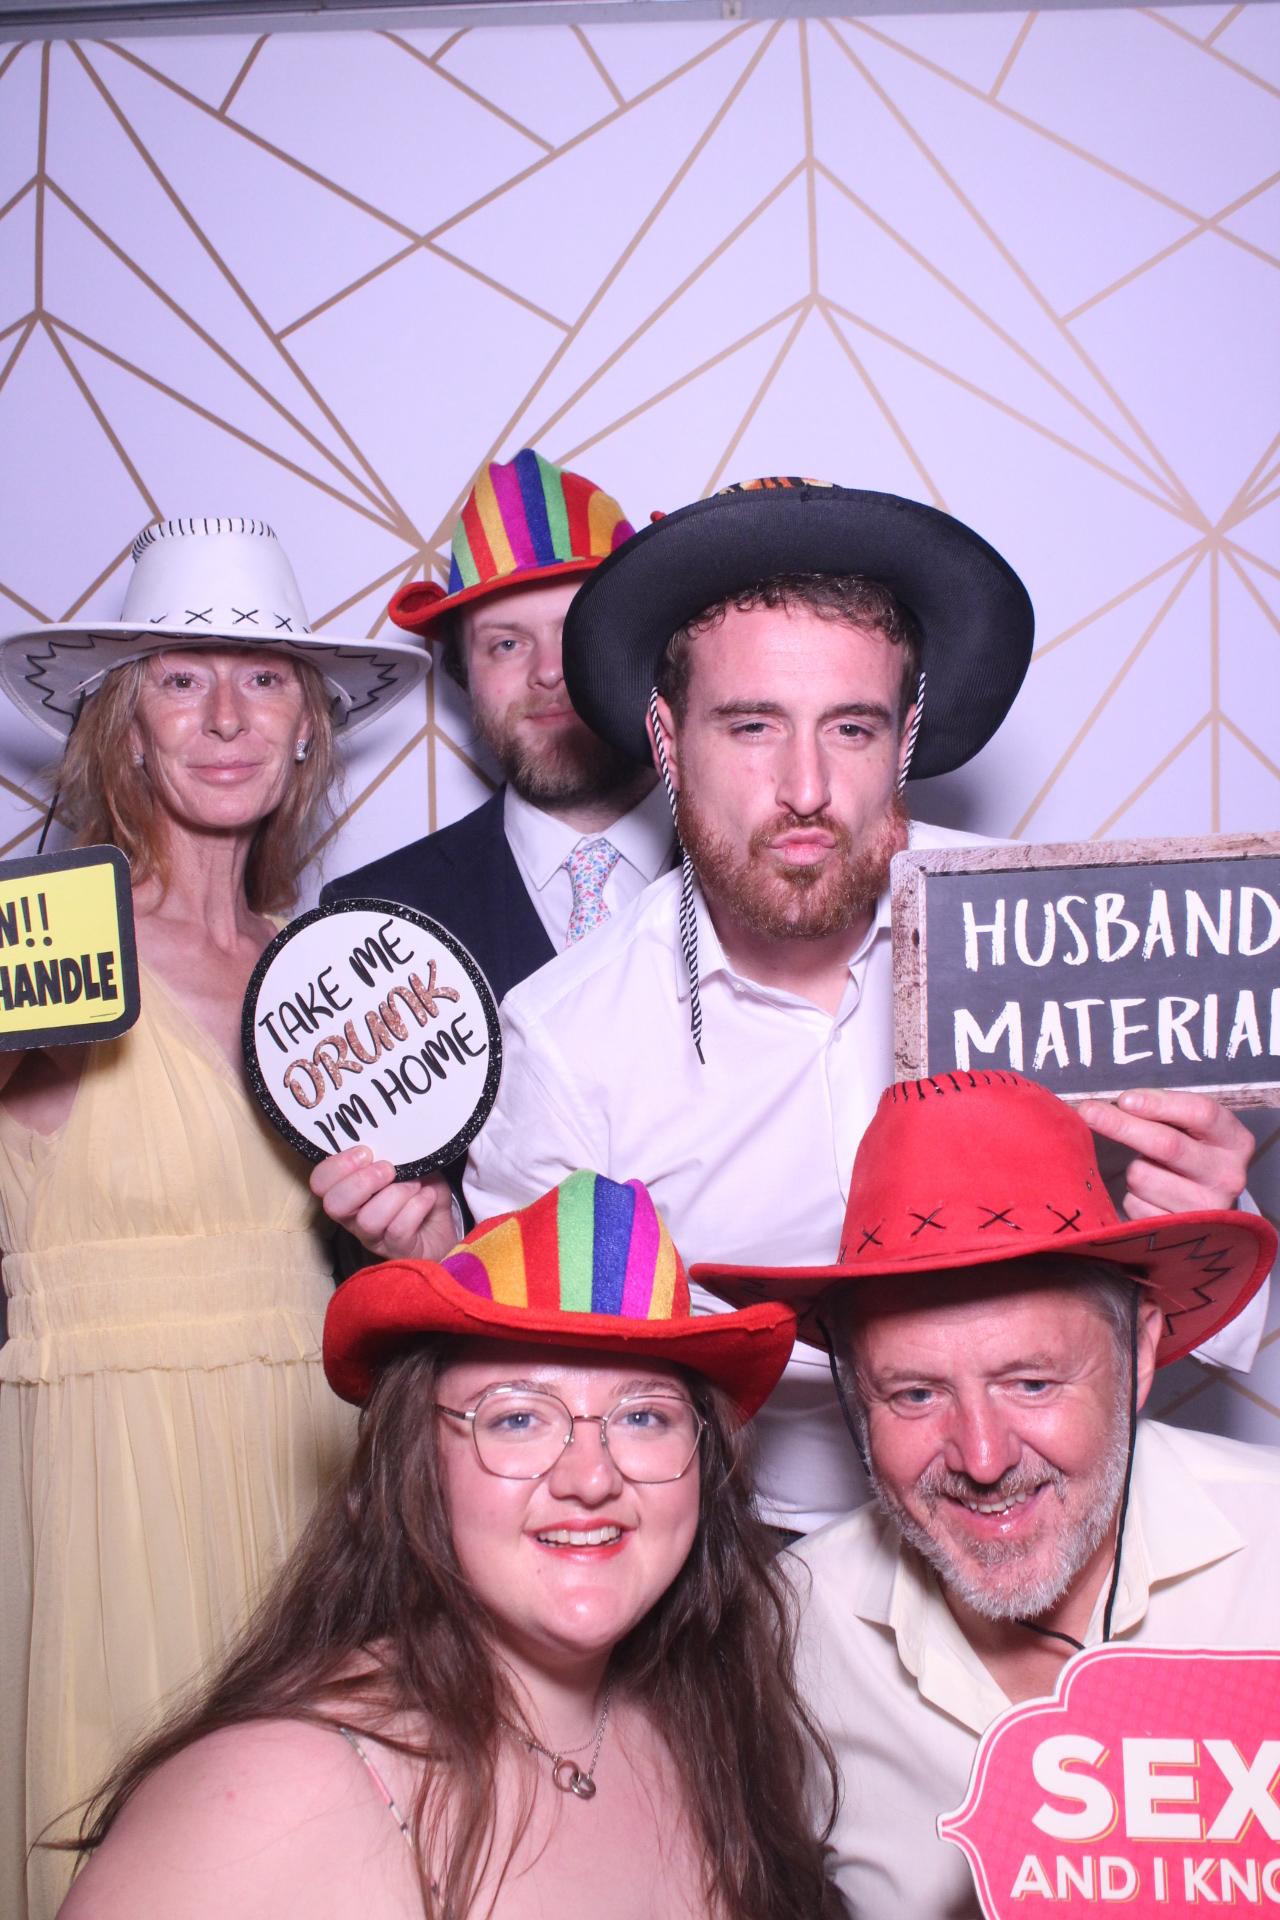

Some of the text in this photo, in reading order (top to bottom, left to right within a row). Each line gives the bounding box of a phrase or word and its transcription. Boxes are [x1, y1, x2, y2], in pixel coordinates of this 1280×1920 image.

[258, 919, 415, 1053] TAKE ME
[962, 886, 1280, 972] HUSBAND
[283, 958, 460, 1109] DRUNK
[314, 1012, 487, 1153] I'M HOME
[1031, 1734, 1280, 1843] SEX
[1009, 1855, 1140, 1901] AND
[1153, 1857, 1168, 1902] I
